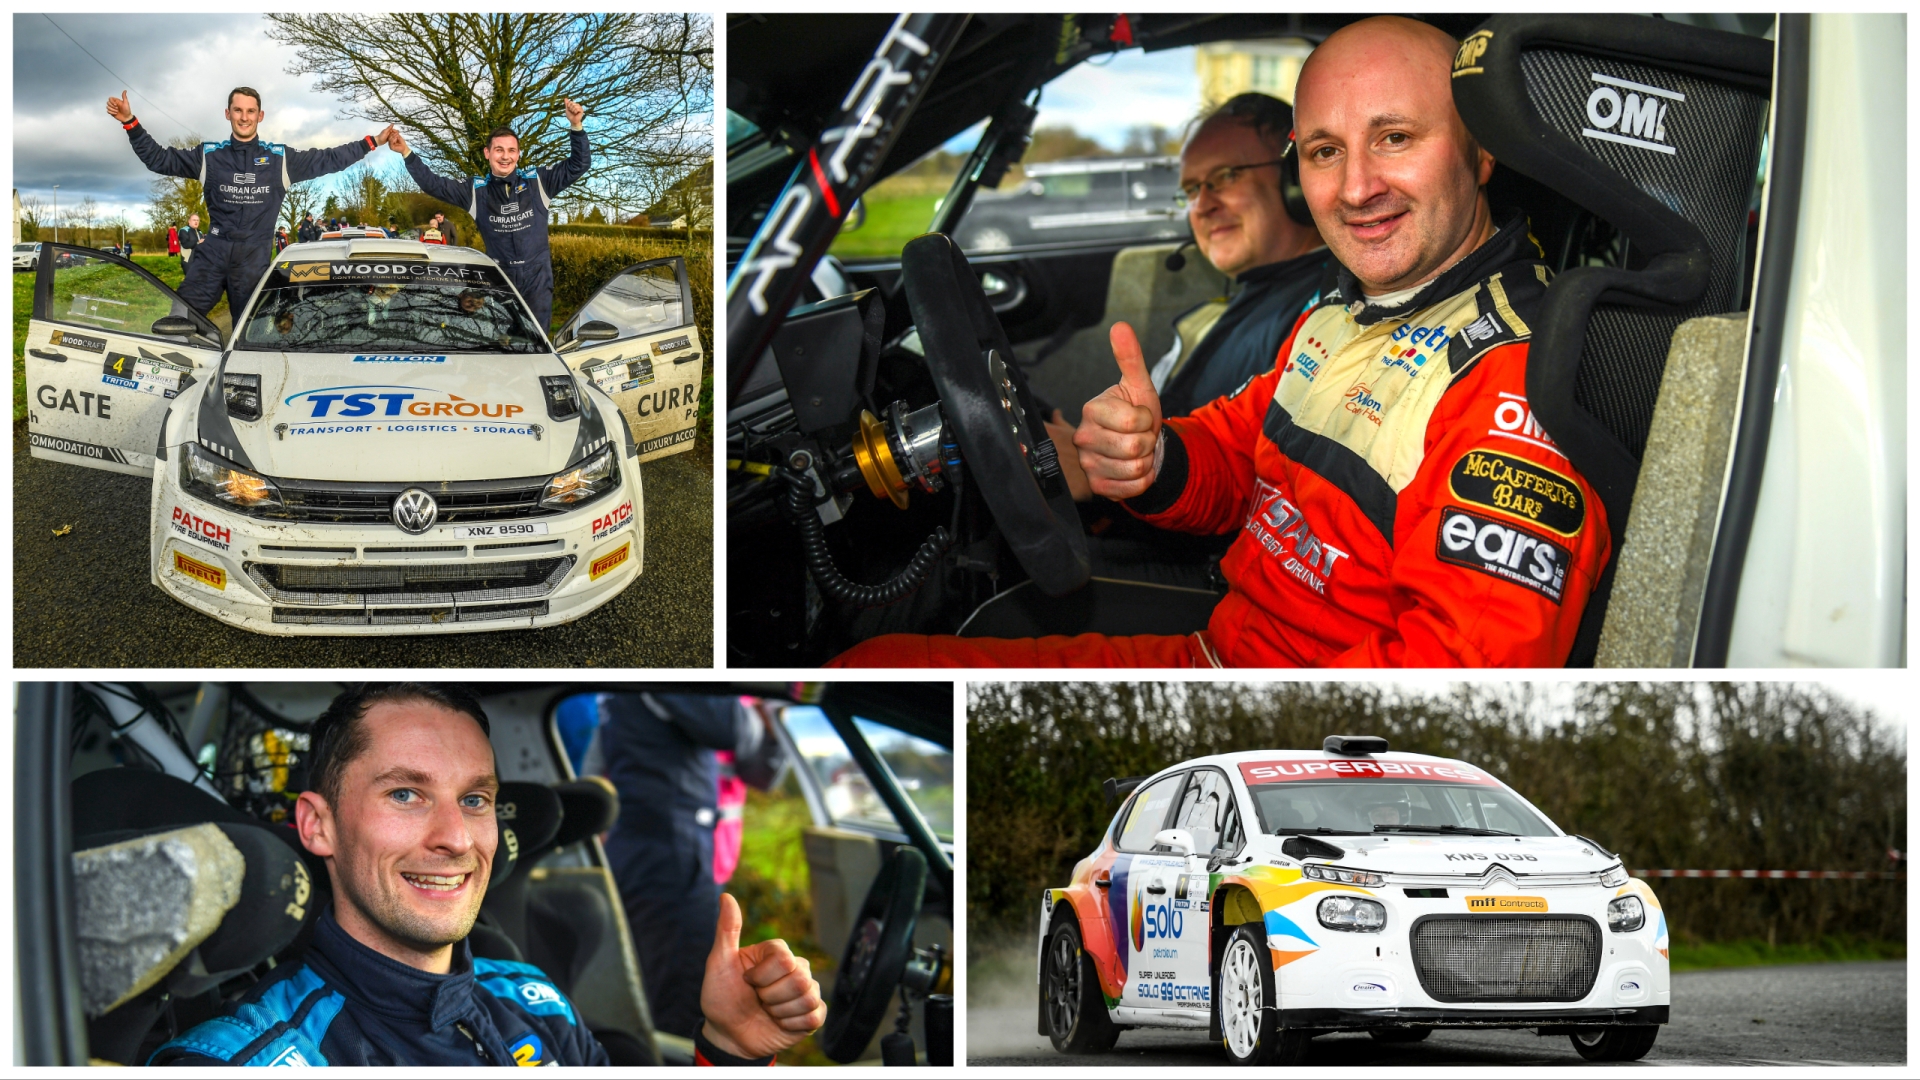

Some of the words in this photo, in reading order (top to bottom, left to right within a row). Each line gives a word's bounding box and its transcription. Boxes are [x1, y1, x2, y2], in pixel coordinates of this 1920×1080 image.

[1453, 36, 1488, 69] OMP
[219, 185, 250, 195] CURRAN
[250, 185, 270, 194] GATE
[488, 214, 516, 224] CURRAN
[516, 209, 534, 221] GATE
[280, 261, 290, 270] 4
[332, 264, 486, 280] WOODCRAFT
[415, 275, 449, 283] KITCHENS
[62, 336, 106, 350] WOODCRAFT
[658, 338, 690, 351] WOODCRAFT
[112, 357, 126, 374] 4
[105, 376, 136, 388] TRITON
[37, 384, 111, 420] GATE
[306, 394, 415, 418] TST
[408, 401, 524, 418] GROUP
[290, 425, 373, 435] TRANSPORT
[473, 426, 534, 435] STORAGE
[643, 434, 674, 454] LUXURY
[172, 506, 231, 543] PATCH
[592, 499, 633, 534] PATCH
[171, 521, 187, 534] TYRE
[187, 529, 230, 551] EQUIPMENT
[468, 527, 495, 536] XNZ
[499, 524, 534, 534] 8590
[592, 529, 608, 542] TYRE
[609, 514, 634, 534] EQUIPMENT
[592, 546, 627, 576] PIRELLI
[1248, 521, 1289, 557] ENERGY
[1281, 557, 1326, 595] DRINK
[177, 555, 222, 585] PIRELLI
[1484, 561, 1498, 573] THE
[1497, 566, 1542, 589] MOTORSPORT
[1541, 584, 1561, 600] STORE
[1250, 761, 1482, 781] SUPERBITES
[1443, 852, 1489, 861] KNS
[1179, 877, 1187, 896] 7
[1471, 898, 1496, 907] mff
[1500, 899, 1545, 908] Contracts
[1145, 897, 1183, 939] solo
[1153, 948, 1179, 959] petroleum
[1138, 971, 1153, 979] SUPER
[1154, 971, 1177, 980] UNLEADED
[1137, 983, 1160, 999] SOLO
[1160, 981, 1174, 1002] 99
[1174, 985, 1211, 1001] OCTANE
